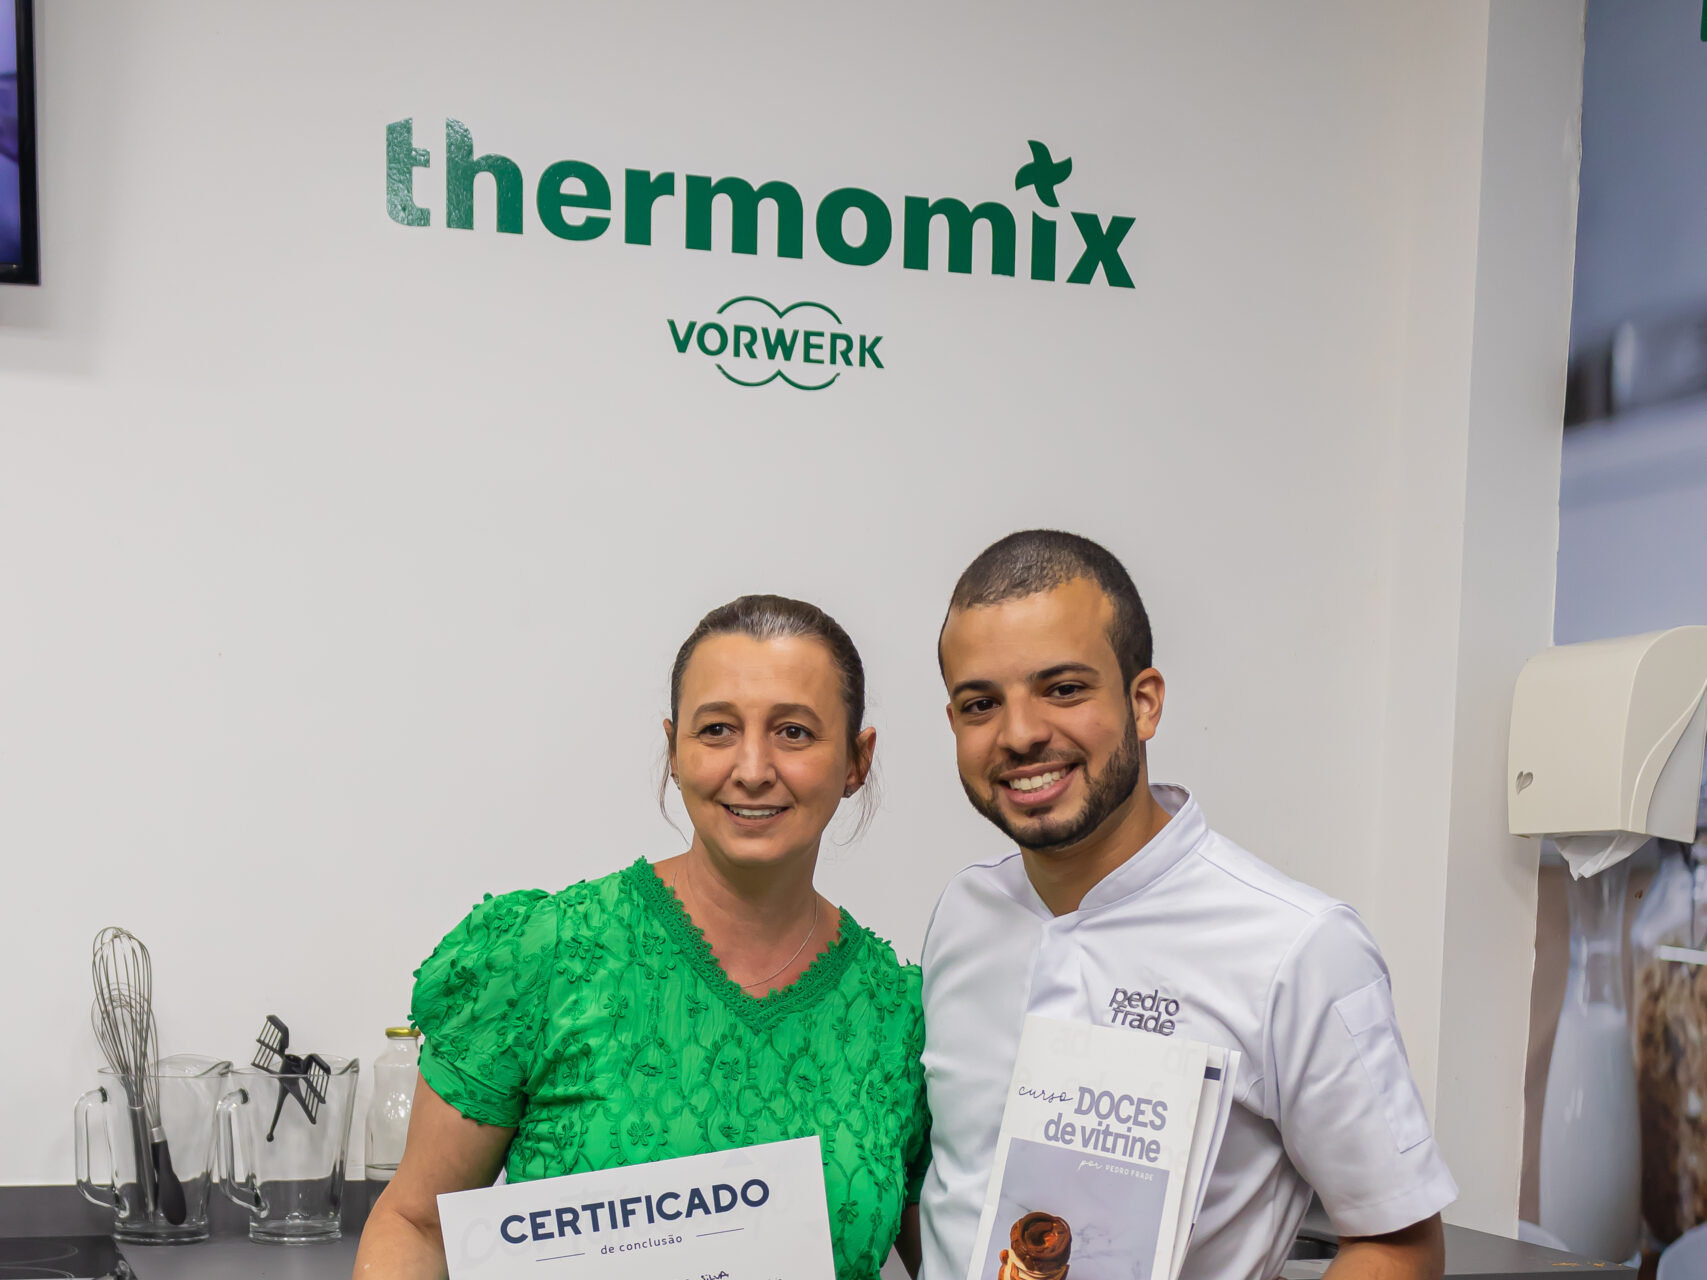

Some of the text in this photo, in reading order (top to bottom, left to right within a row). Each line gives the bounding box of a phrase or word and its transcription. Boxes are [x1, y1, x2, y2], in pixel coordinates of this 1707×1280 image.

[386, 117, 1136, 289] thermomix
[667, 319, 885, 369] VORWERK
[1108, 987, 1180, 1017] pedro
[1111, 1004, 1176, 1036] frade
[1018, 1085, 1168, 1131] curso DOCES
[1044, 1112, 1161, 1163] de vitrine
[1105, 1164, 1129, 1176] PEDRO
[1131, 1169, 1154, 1181] FRADE
[500, 1178, 770, 1244] CERTIFICADO
[600, 1234, 683, 1255] de conclusão
